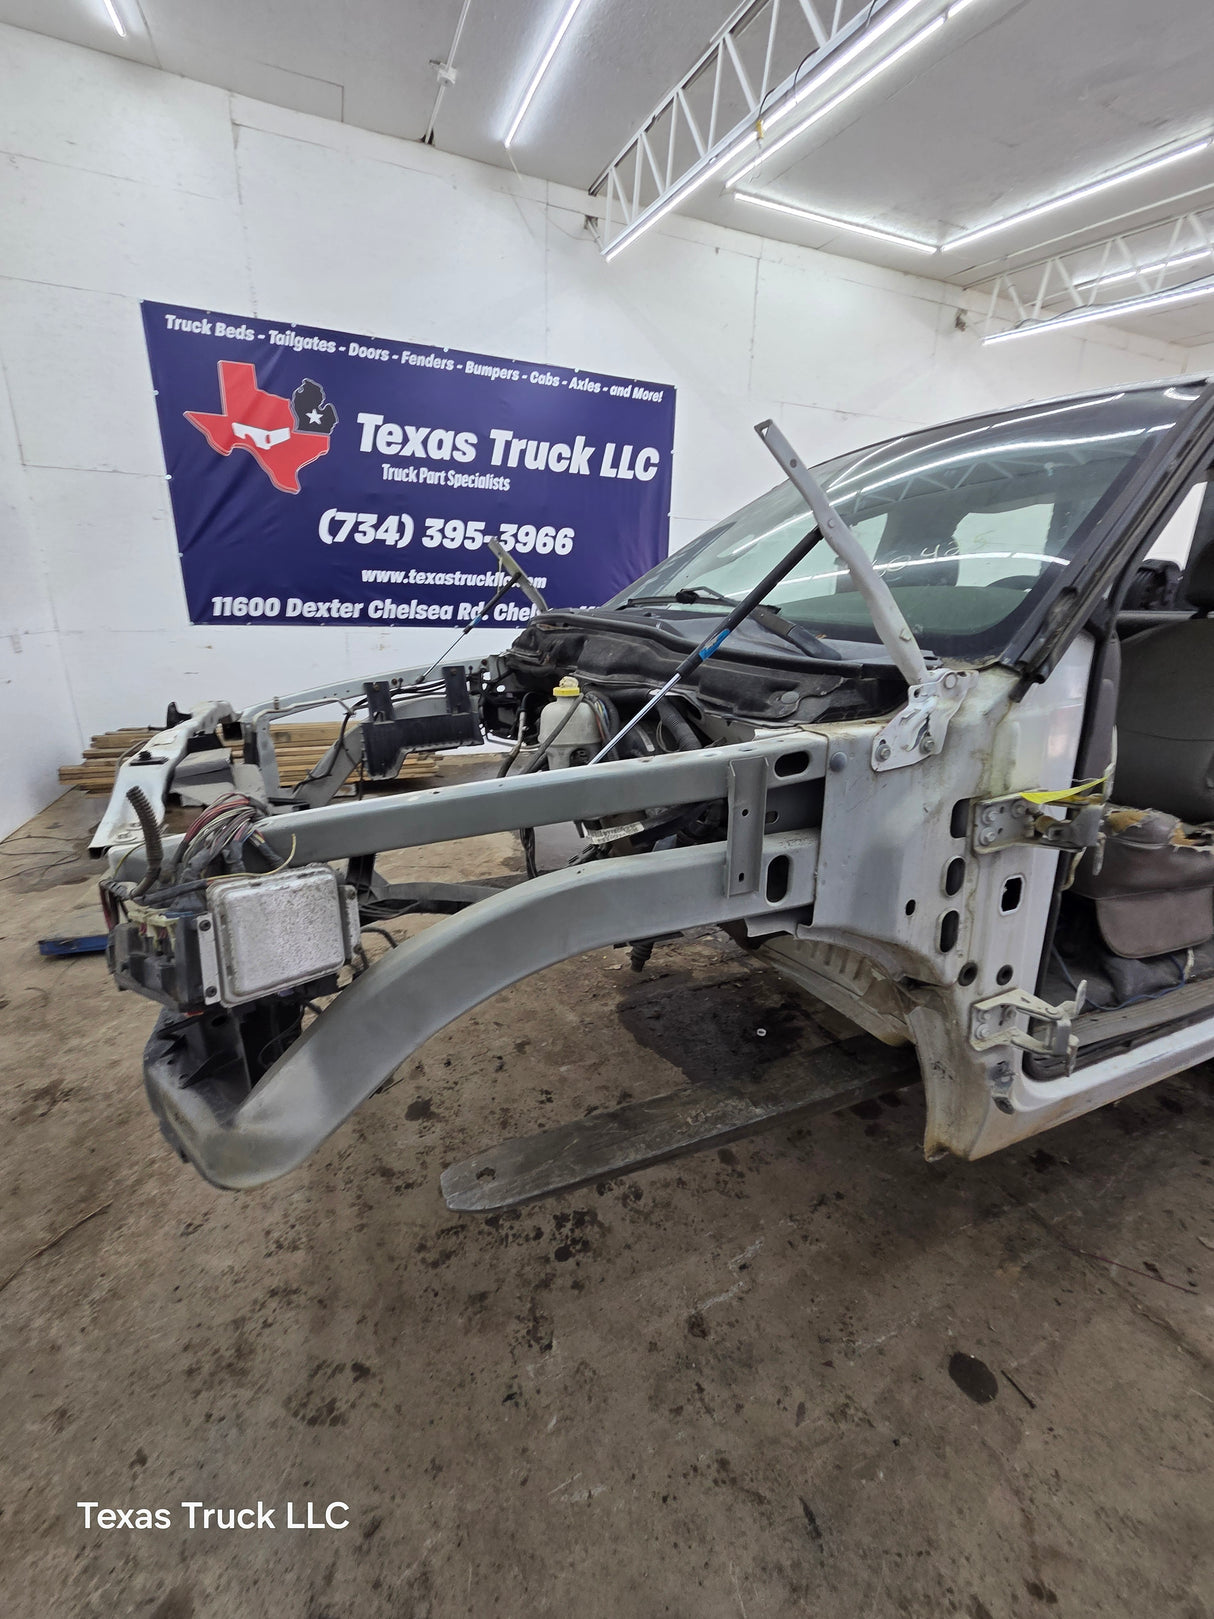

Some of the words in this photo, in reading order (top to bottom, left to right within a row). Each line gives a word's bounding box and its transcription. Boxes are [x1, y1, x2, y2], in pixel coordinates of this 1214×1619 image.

[164, 314, 213, 336] Truck
[214, 321, 255, 341] Beds
[268, 329, 337, 354] Tailgates
[348, 342, 390, 362] Doors
[401, 350, 455, 371] Fenders
[464, 360, 521, 381] Bumpers
[529, 370, 561, 387] Cabs
[568, 376, 602, 394] Axles
[609, 384, 633, 398] and
[631, 386, 664, 403] More!
[356, 412, 479, 463] Texas
[489, 428, 596, 476] Truck
[599, 442, 660, 482] LLC
[381, 463, 419, 483] Truck
[418, 467, 447, 486] Part
[446, 469, 511, 492] Specialists
[318, 507, 415, 549] (734)
[421, 517, 575, 557] 395-3966
[361, 569, 548, 589] www.texastruckllc.m
[211, 596, 281, 617] 11600
[285, 597, 364, 618] Dexter
[367, 598, 454, 620] Chelsea
[456, 601, 489, 622] Rd.
[493, 602, 541, 622] Chel
